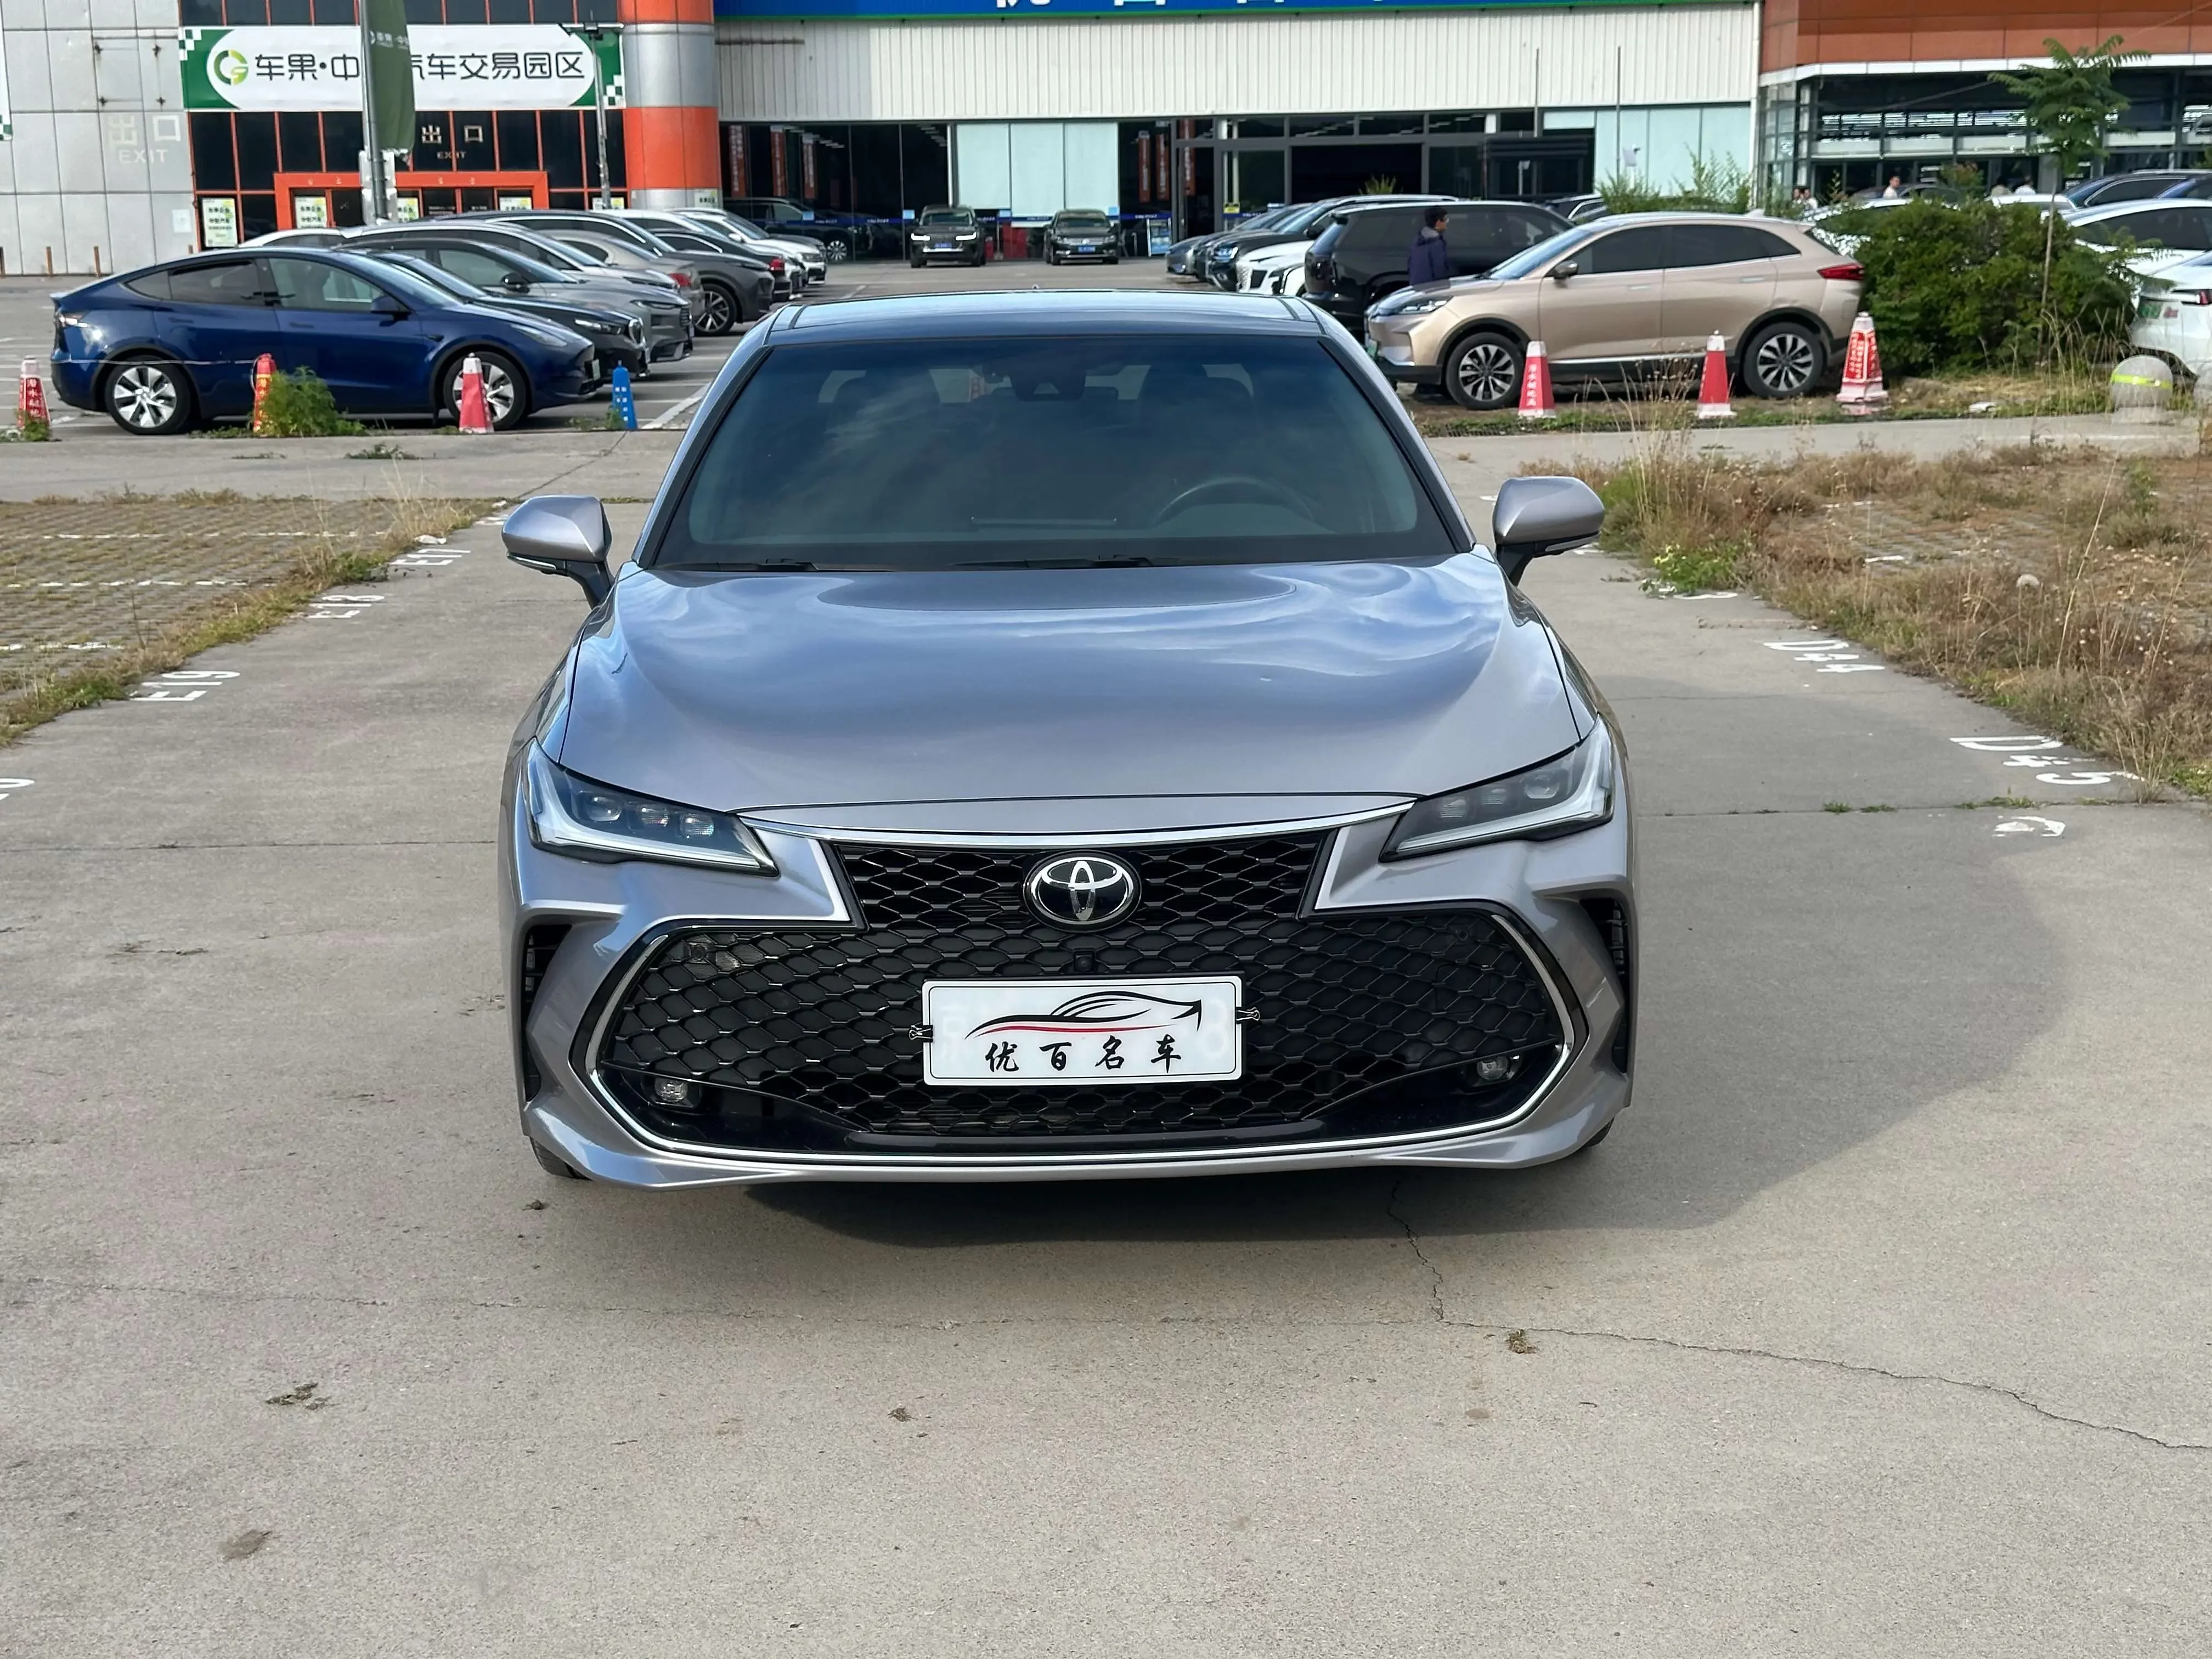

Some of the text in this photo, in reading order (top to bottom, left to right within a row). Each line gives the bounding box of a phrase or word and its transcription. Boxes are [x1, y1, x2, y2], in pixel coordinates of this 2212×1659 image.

[255, 52, 585, 81] 车果·中车交易园区
[421, 125, 483, 144] 出口
[119, 149, 168, 163] EXIT
[388, 548, 471, 566] E17
[1763, 639, 1885, 674] D44
[128, 670, 241, 702] E19
[1949, 735, 2146, 785] D45
[985, 1035, 1182, 1073] 优百名车
